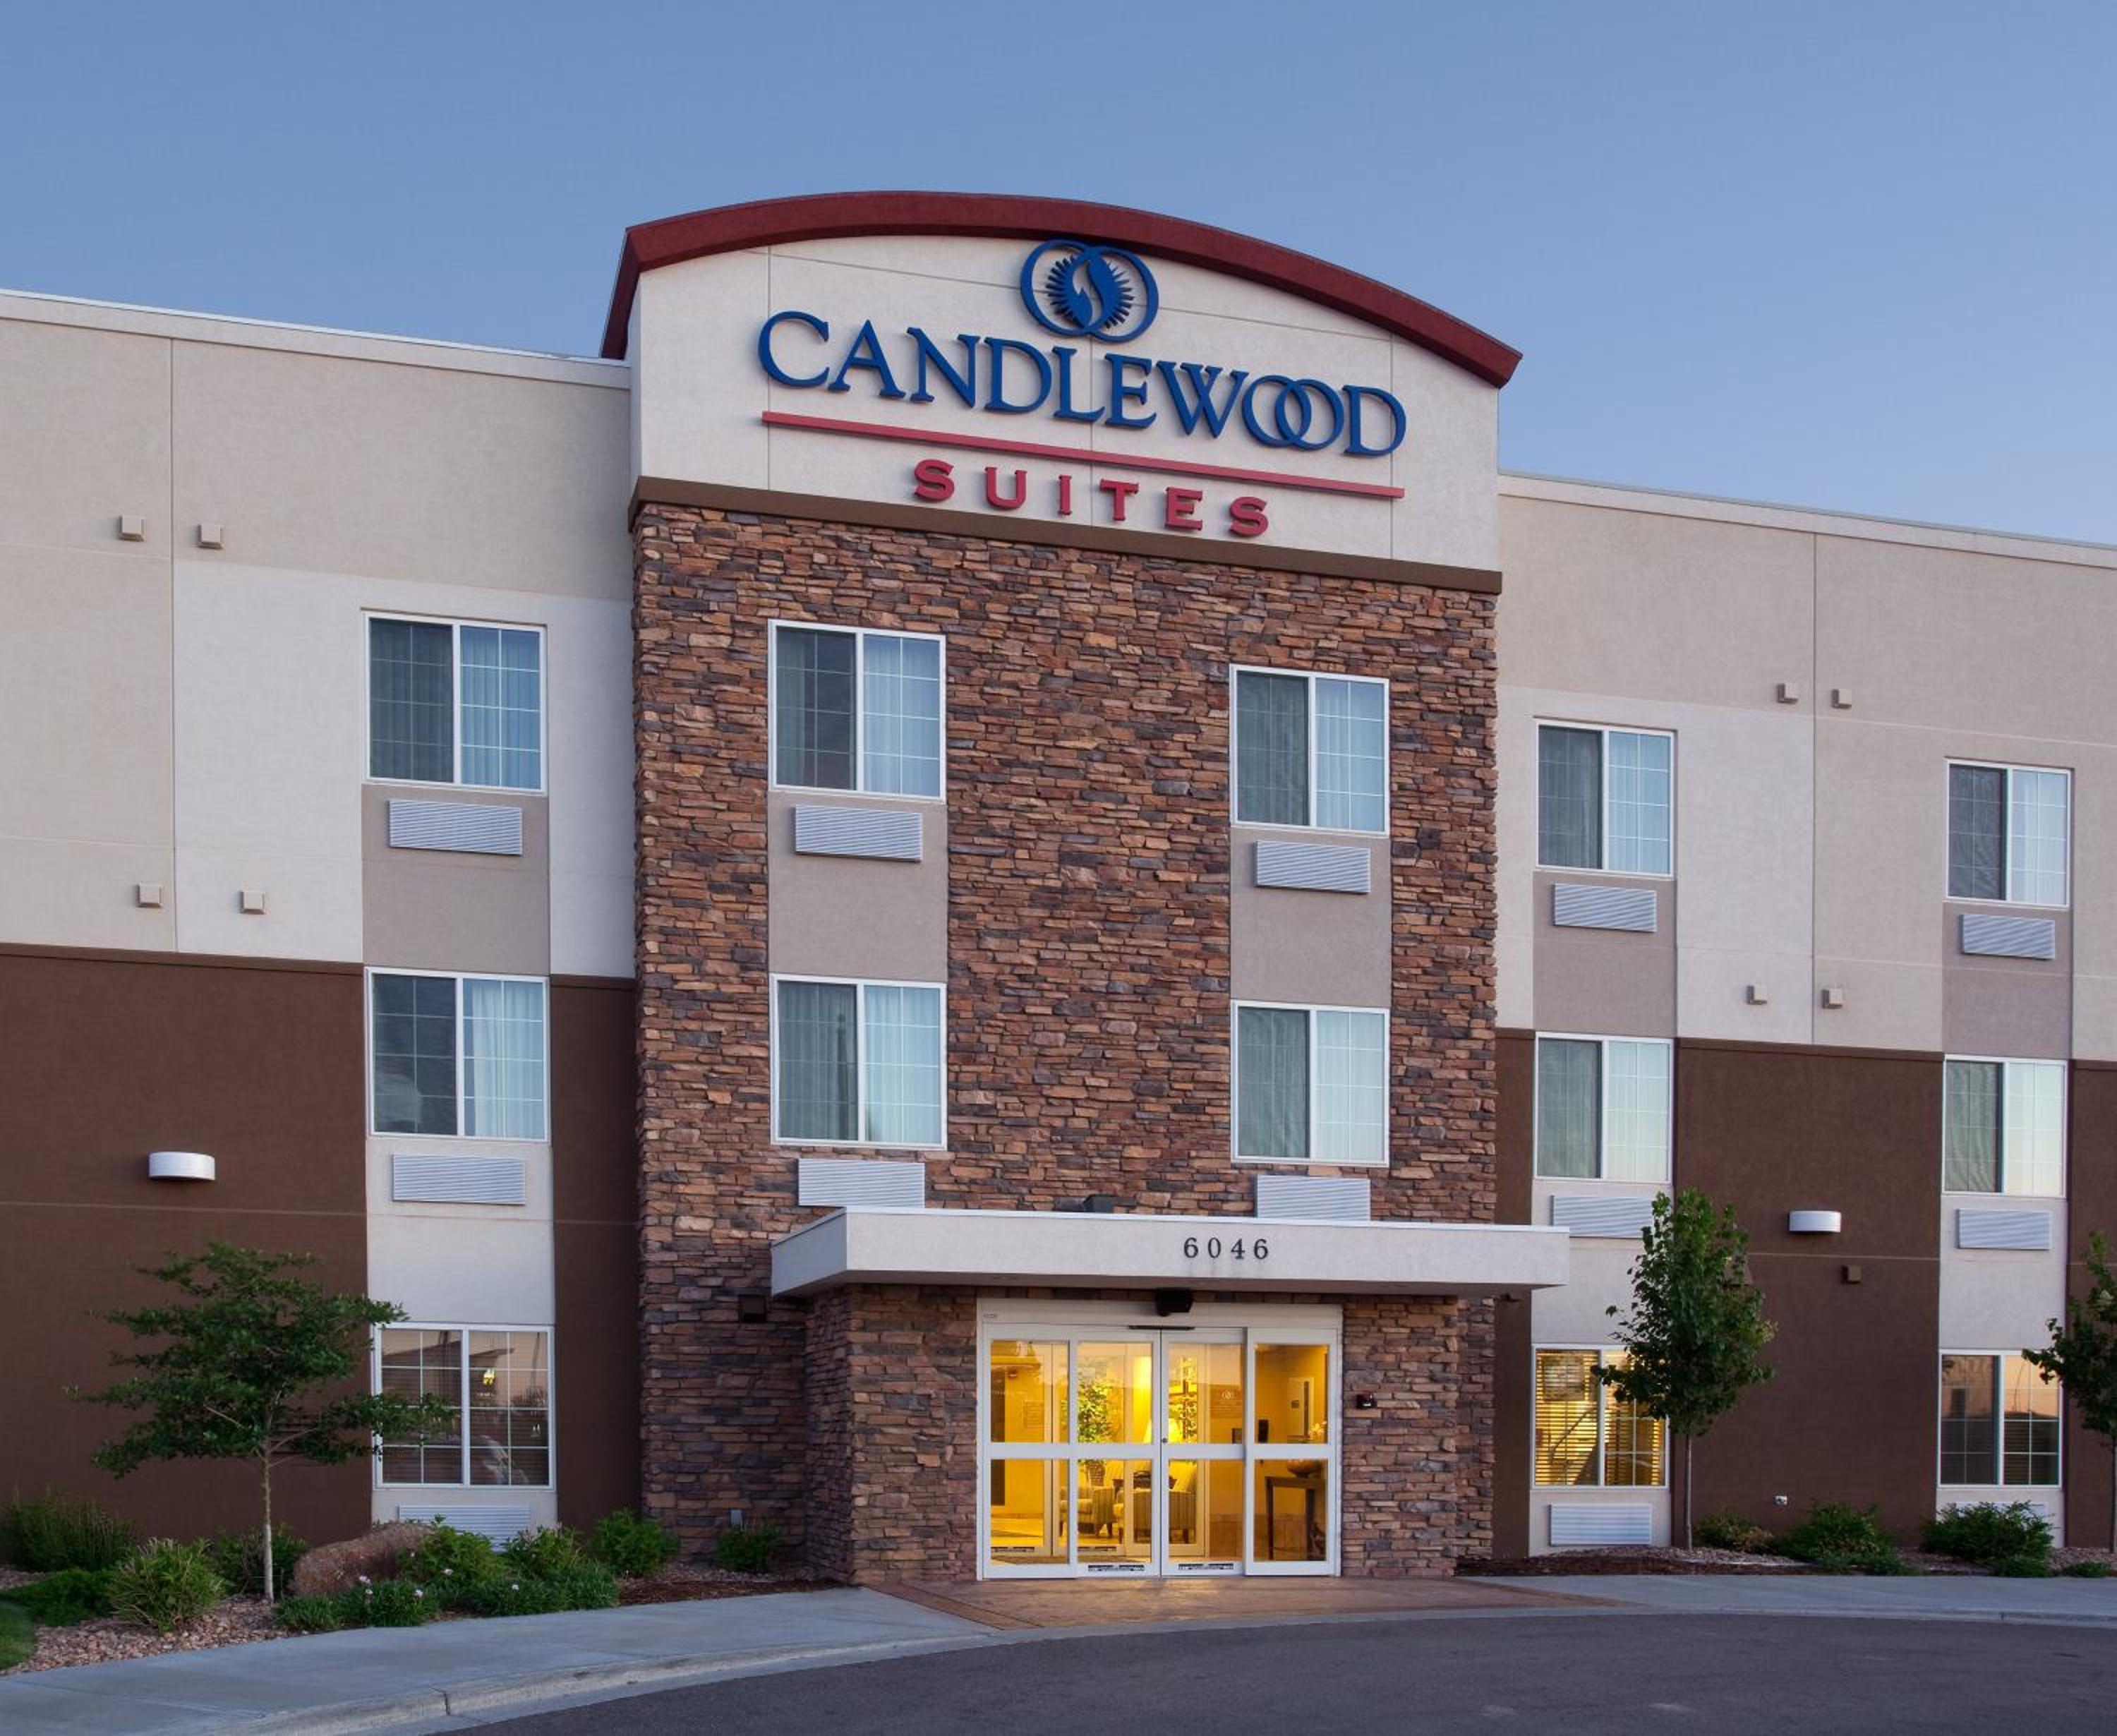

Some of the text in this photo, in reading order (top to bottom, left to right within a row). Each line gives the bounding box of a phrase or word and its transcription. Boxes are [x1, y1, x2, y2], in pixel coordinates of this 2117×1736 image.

[757, 311, 1406, 457] CANDLEWOOD
[913, 459, 1271, 537] SUITES
[1183, 1236, 1269, 1260] 6046
